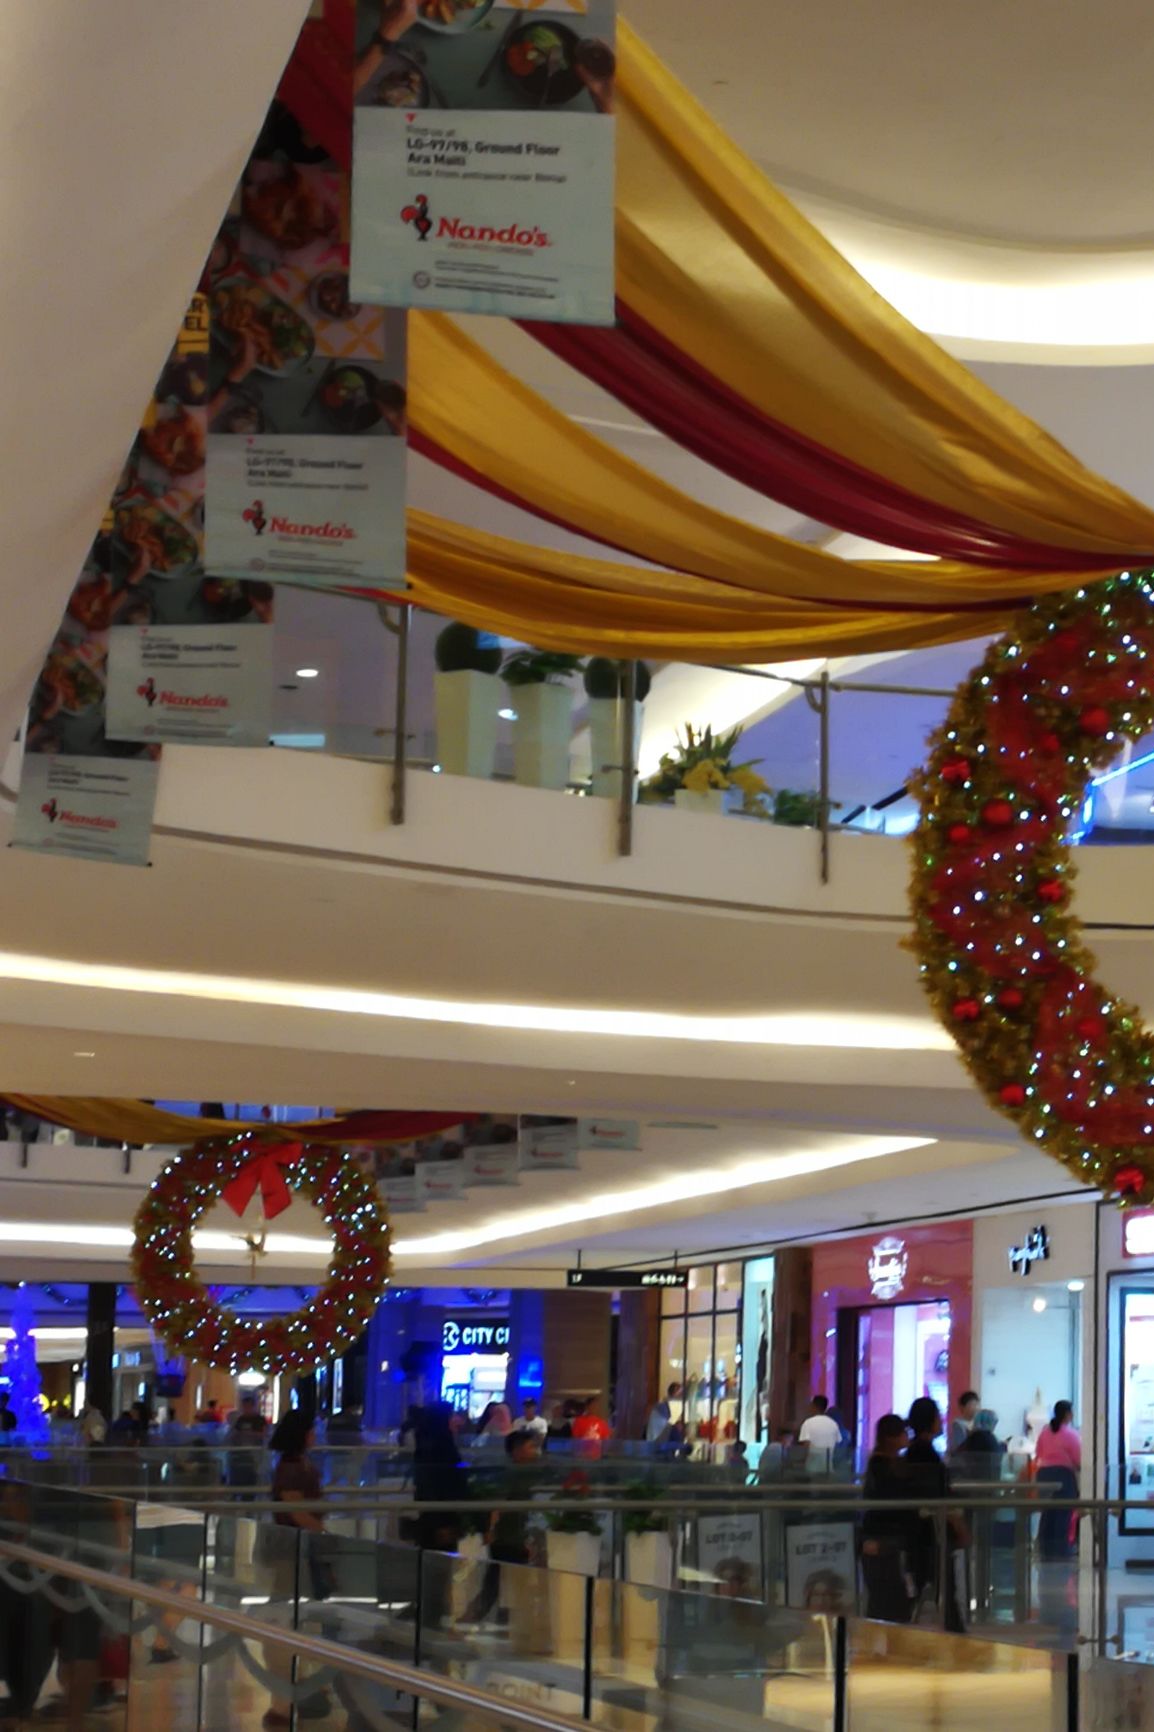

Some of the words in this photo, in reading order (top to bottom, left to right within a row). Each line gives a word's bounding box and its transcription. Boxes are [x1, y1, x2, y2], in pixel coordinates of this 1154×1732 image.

[475, 142, 522, 154] Ground
[526, 143, 559, 155] Floor
[408, 152, 431, 164] Ara
[436, 217, 551, 248] Nando's
[269, 516, 356, 540] Nando's
[463, 1327, 494, 1345] CITY
